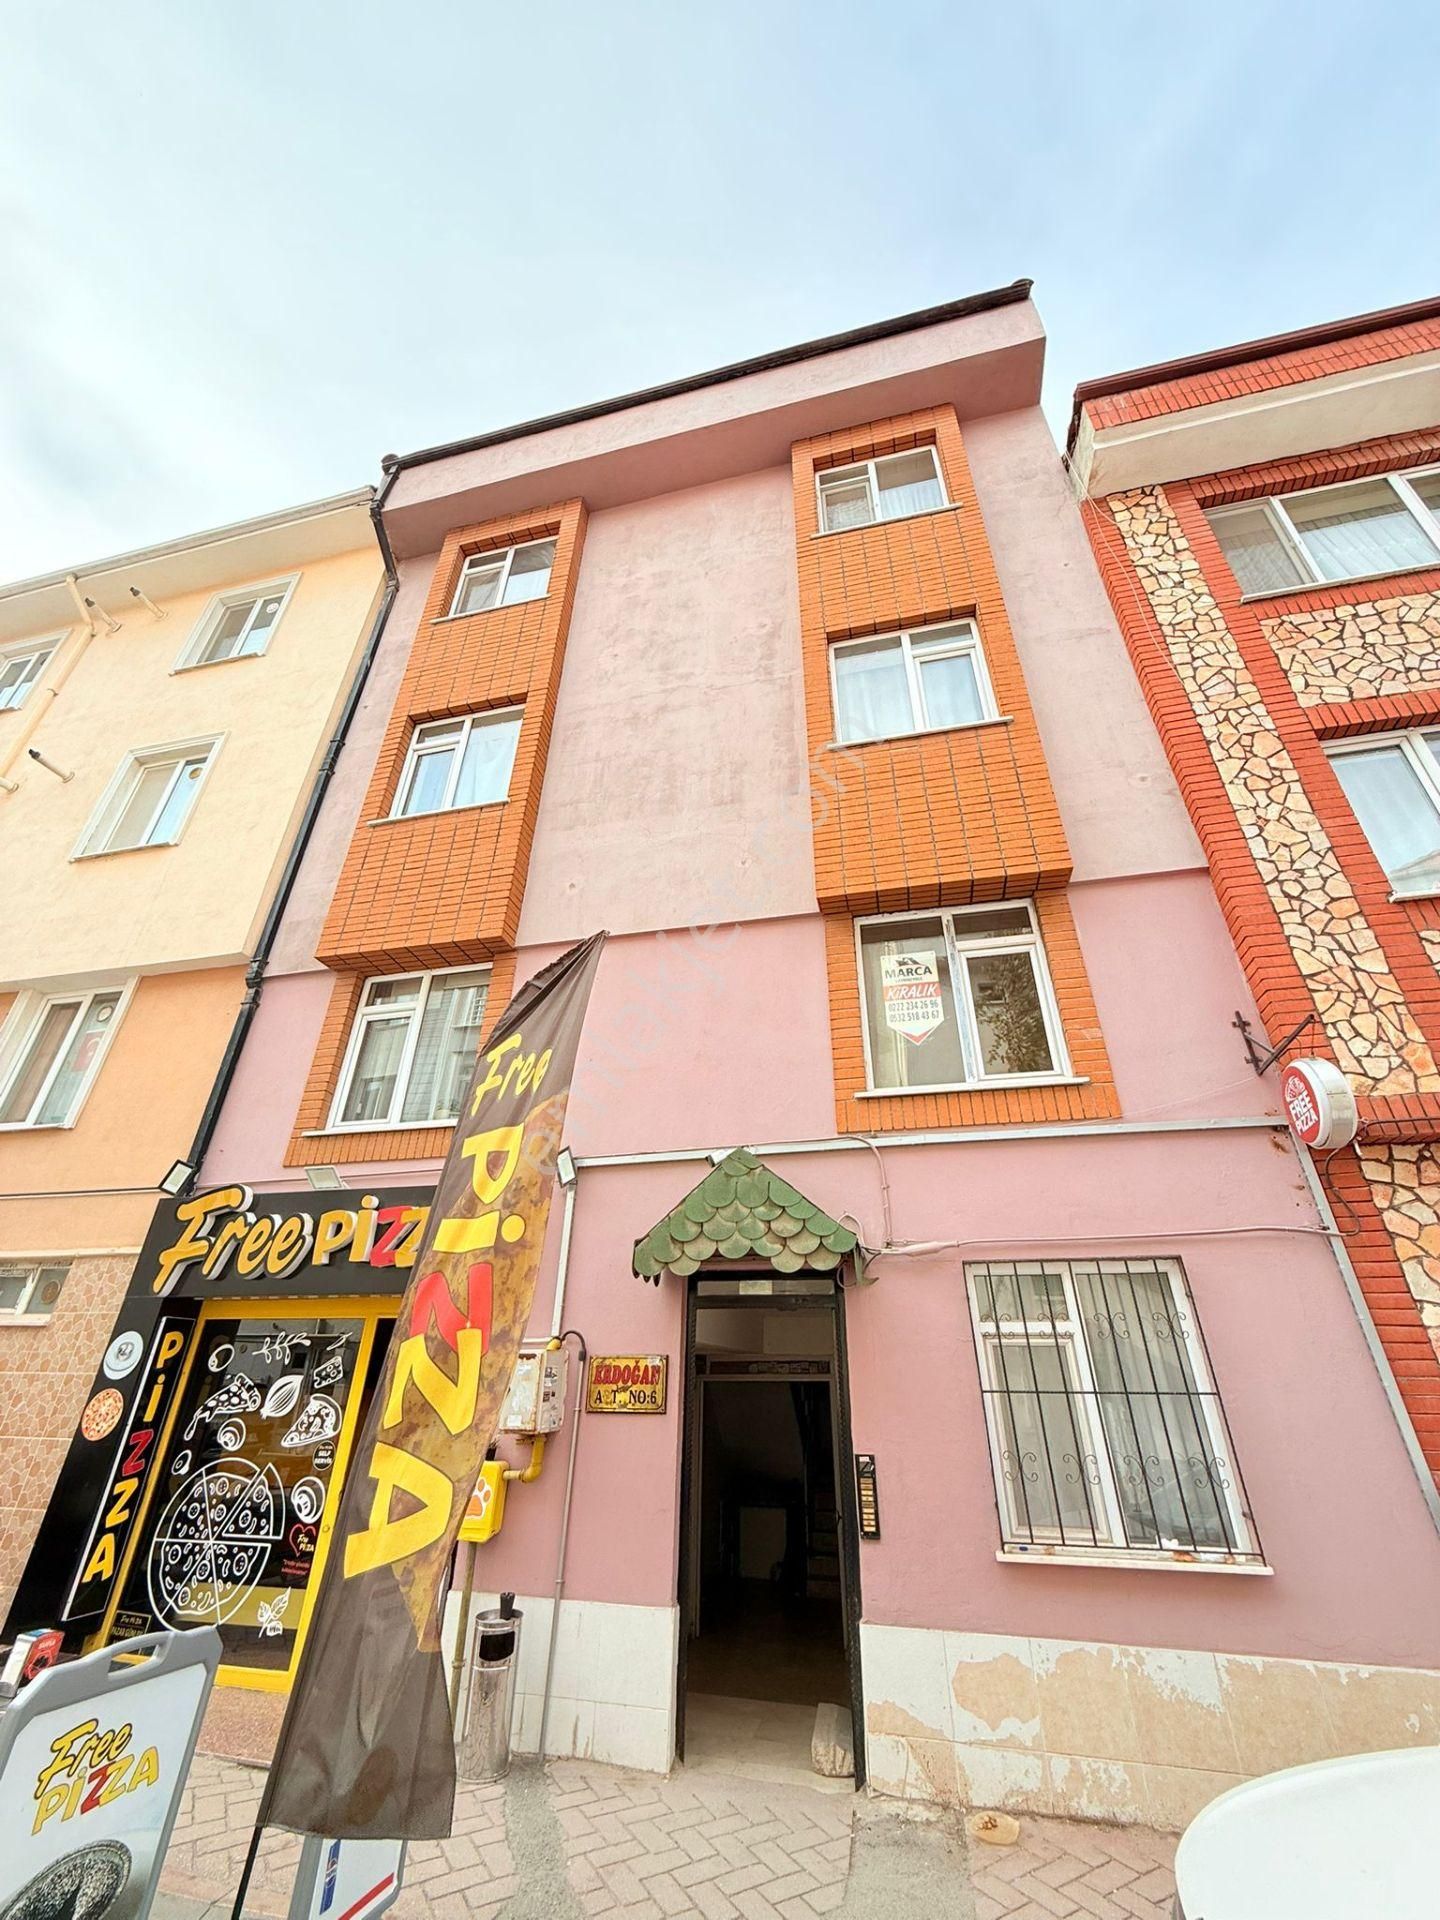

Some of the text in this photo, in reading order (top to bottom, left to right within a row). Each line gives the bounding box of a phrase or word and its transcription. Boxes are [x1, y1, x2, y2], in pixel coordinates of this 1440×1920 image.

[885, 966, 932, 979] MARCA
[888, 1002, 904, 1012] 0222
[906, 1001, 919, 1011] 234
[920, 1000, 928, 1009] 26
[889, 1013, 905, 1023] 0532
[907, 1011, 920, 1021] 518
[921, 1010, 930, 1020] 43
[472, 1032, 553, 1118] Free
[1289, 1089, 1313, 1122] FREE
[1295, 1107, 1319, 1136] PIZZA
[153, 1184, 431, 1296] Free PiZZ
[592, 1361, 661, 1386] ERDOĞAN
[628, 1389, 657, 1405] NO:6
[34, 1717, 133, 1800] Free
